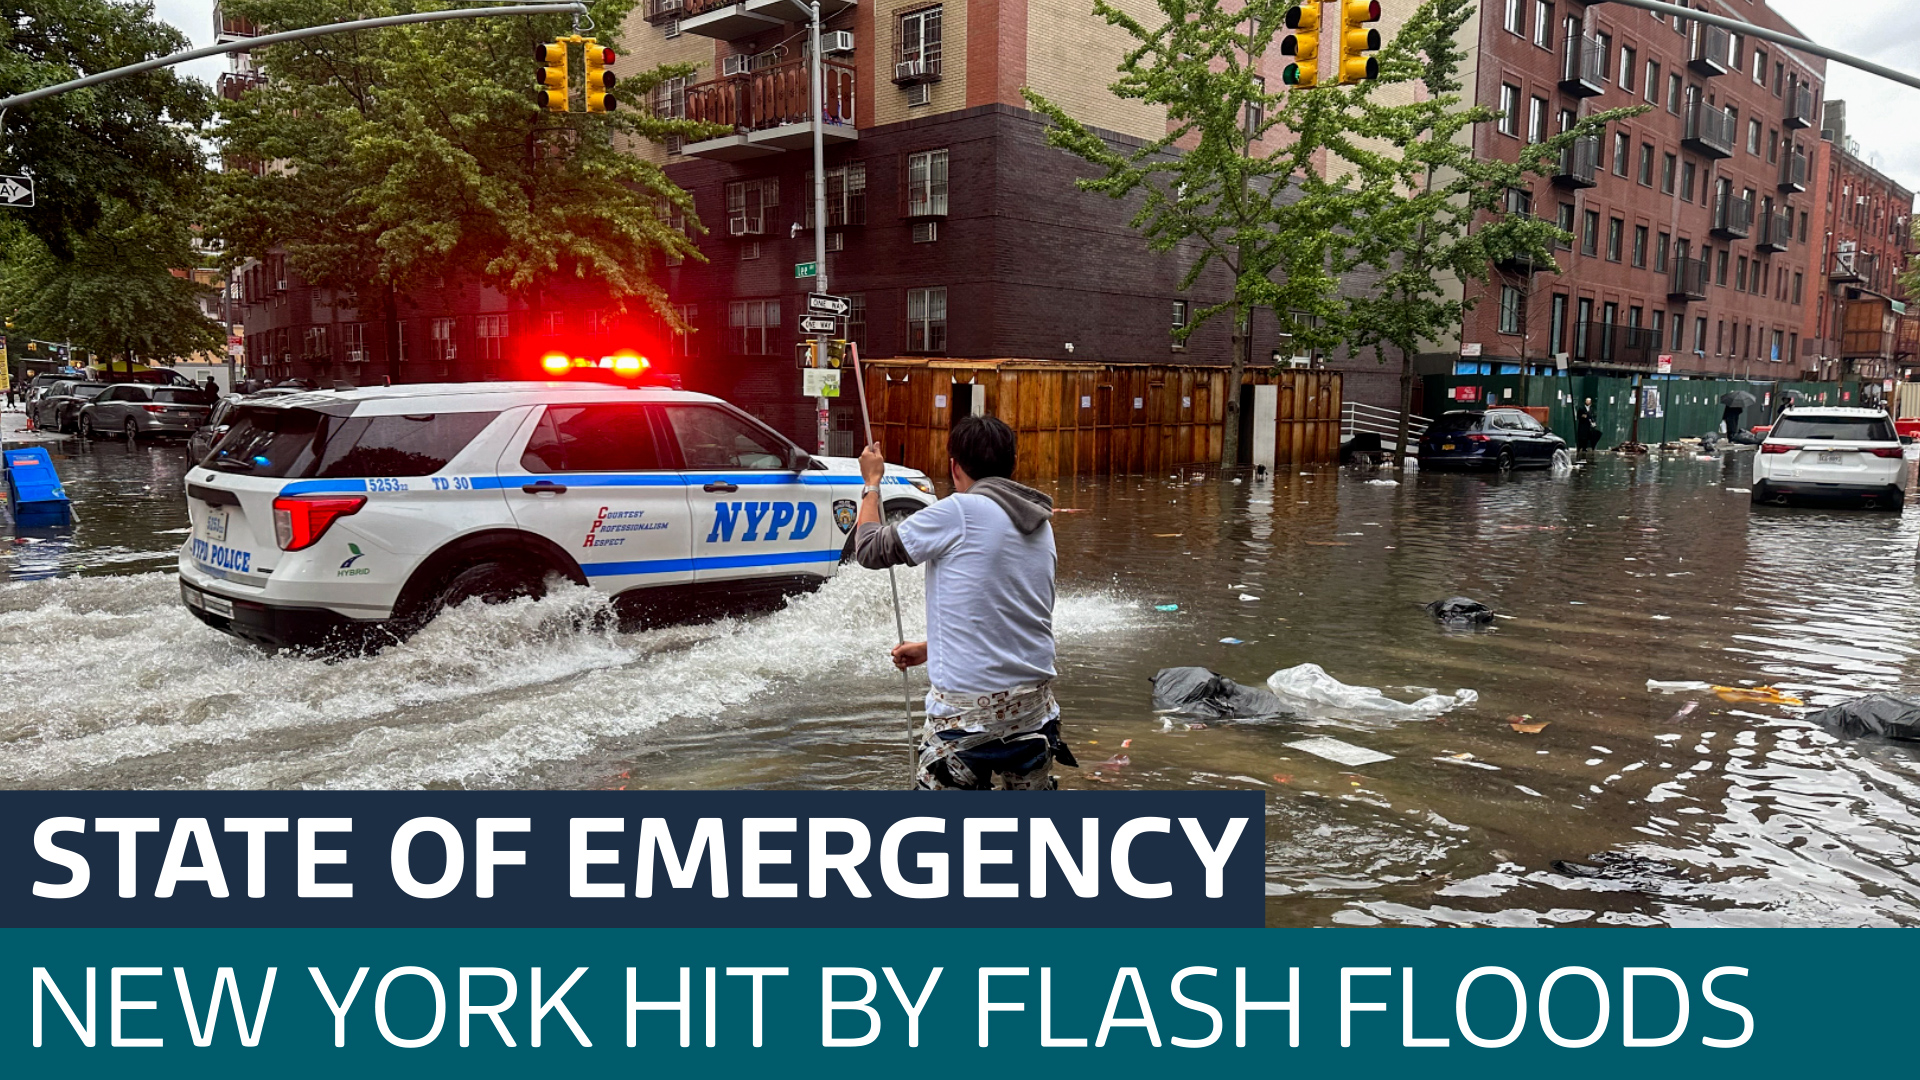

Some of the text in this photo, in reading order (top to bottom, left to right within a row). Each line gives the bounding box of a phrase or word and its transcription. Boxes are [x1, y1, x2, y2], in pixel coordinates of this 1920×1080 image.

[0, 185, 19, 197] AY
[832, 302, 844, 310] WAY
[806, 321, 816, 329] ONE
[431, 477, 449, 490] TD
[453, 477, 469, 490] 30
[597, 506, 644, 519] COURTESY
[590, 520, 669, 533] PROFESSIONALISM
[706, 502, 818, 543] NYPD
[582, 534, 626, 547] RESPECT
[192, 538, 251, 573] NYPD POLICE
[337, 567, 371, 578] HYBRID
